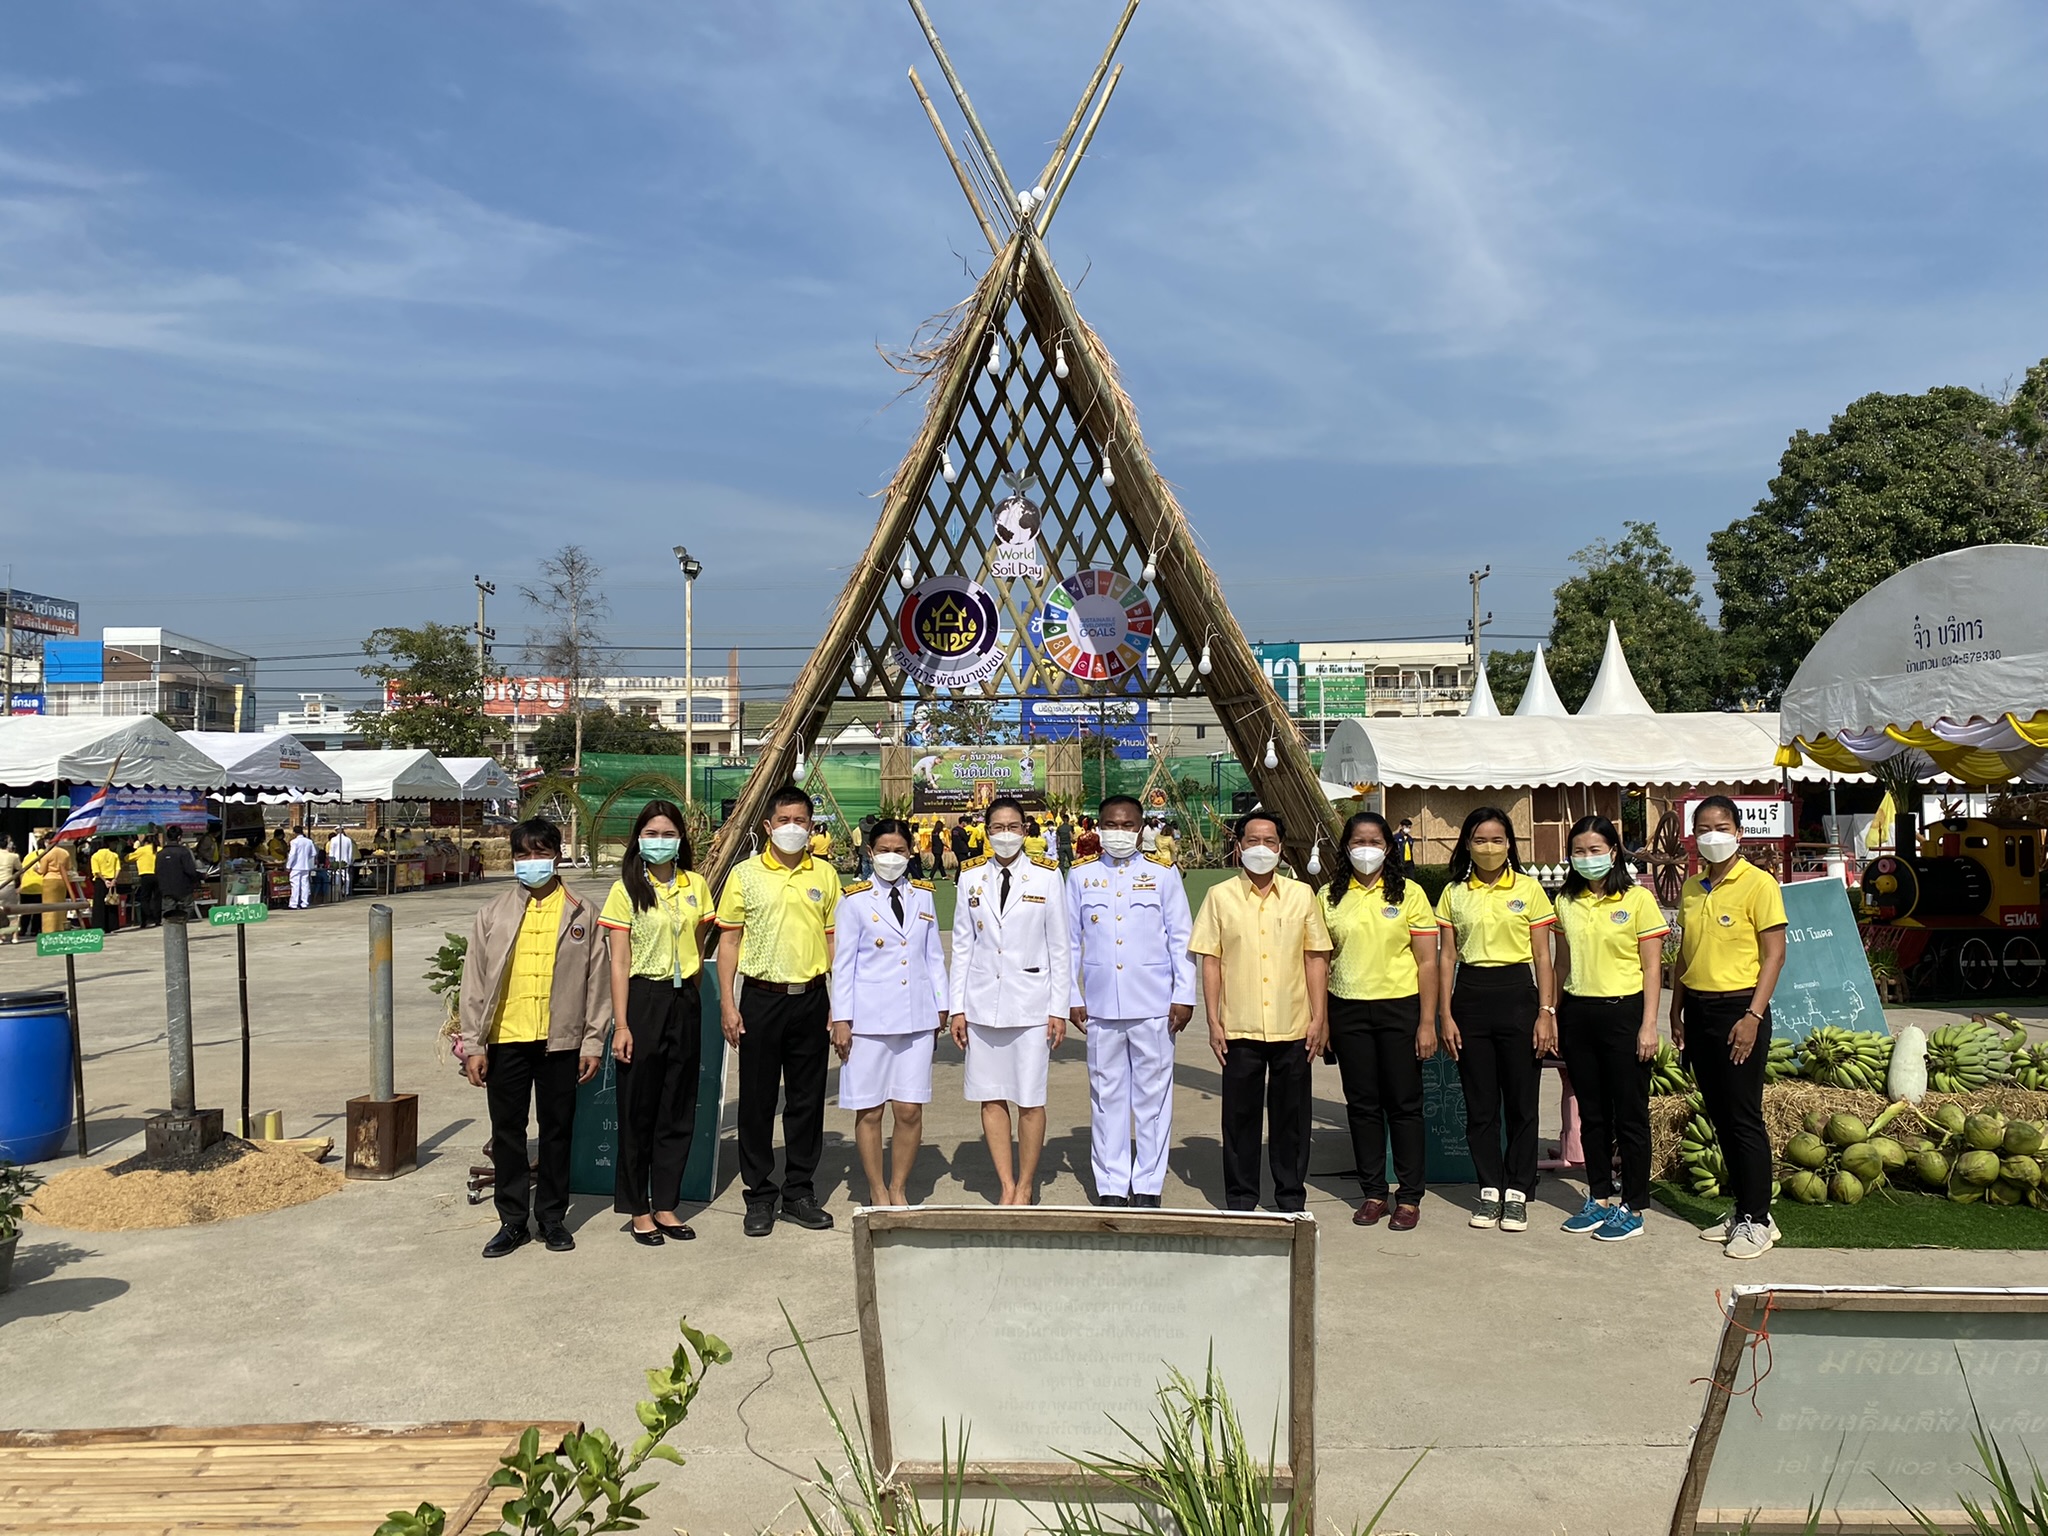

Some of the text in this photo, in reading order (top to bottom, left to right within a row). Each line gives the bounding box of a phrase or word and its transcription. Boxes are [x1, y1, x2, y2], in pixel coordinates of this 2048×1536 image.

[998, 547, 1035, 560] World
[992, 562, 1042, 579] Soil Day
[1080, 628, 1116, 637] GOALS
[1937, 616, 1983, 646] บริการ
[894, 649, 1005, 687] กรมการพัฒนาชุมชน
[1906, 650, 2001, 673] บ้านทวน 034-579330
[970, 752, 1003, 761] ธันวาคม
[952, 761, 1011, 779] วันดินโลก
[1738, 803, 1779, 825] นบุรี
[1744, 826, 1771, 835] ABURI
[1806, 927, 1833, 939] โมเดล
